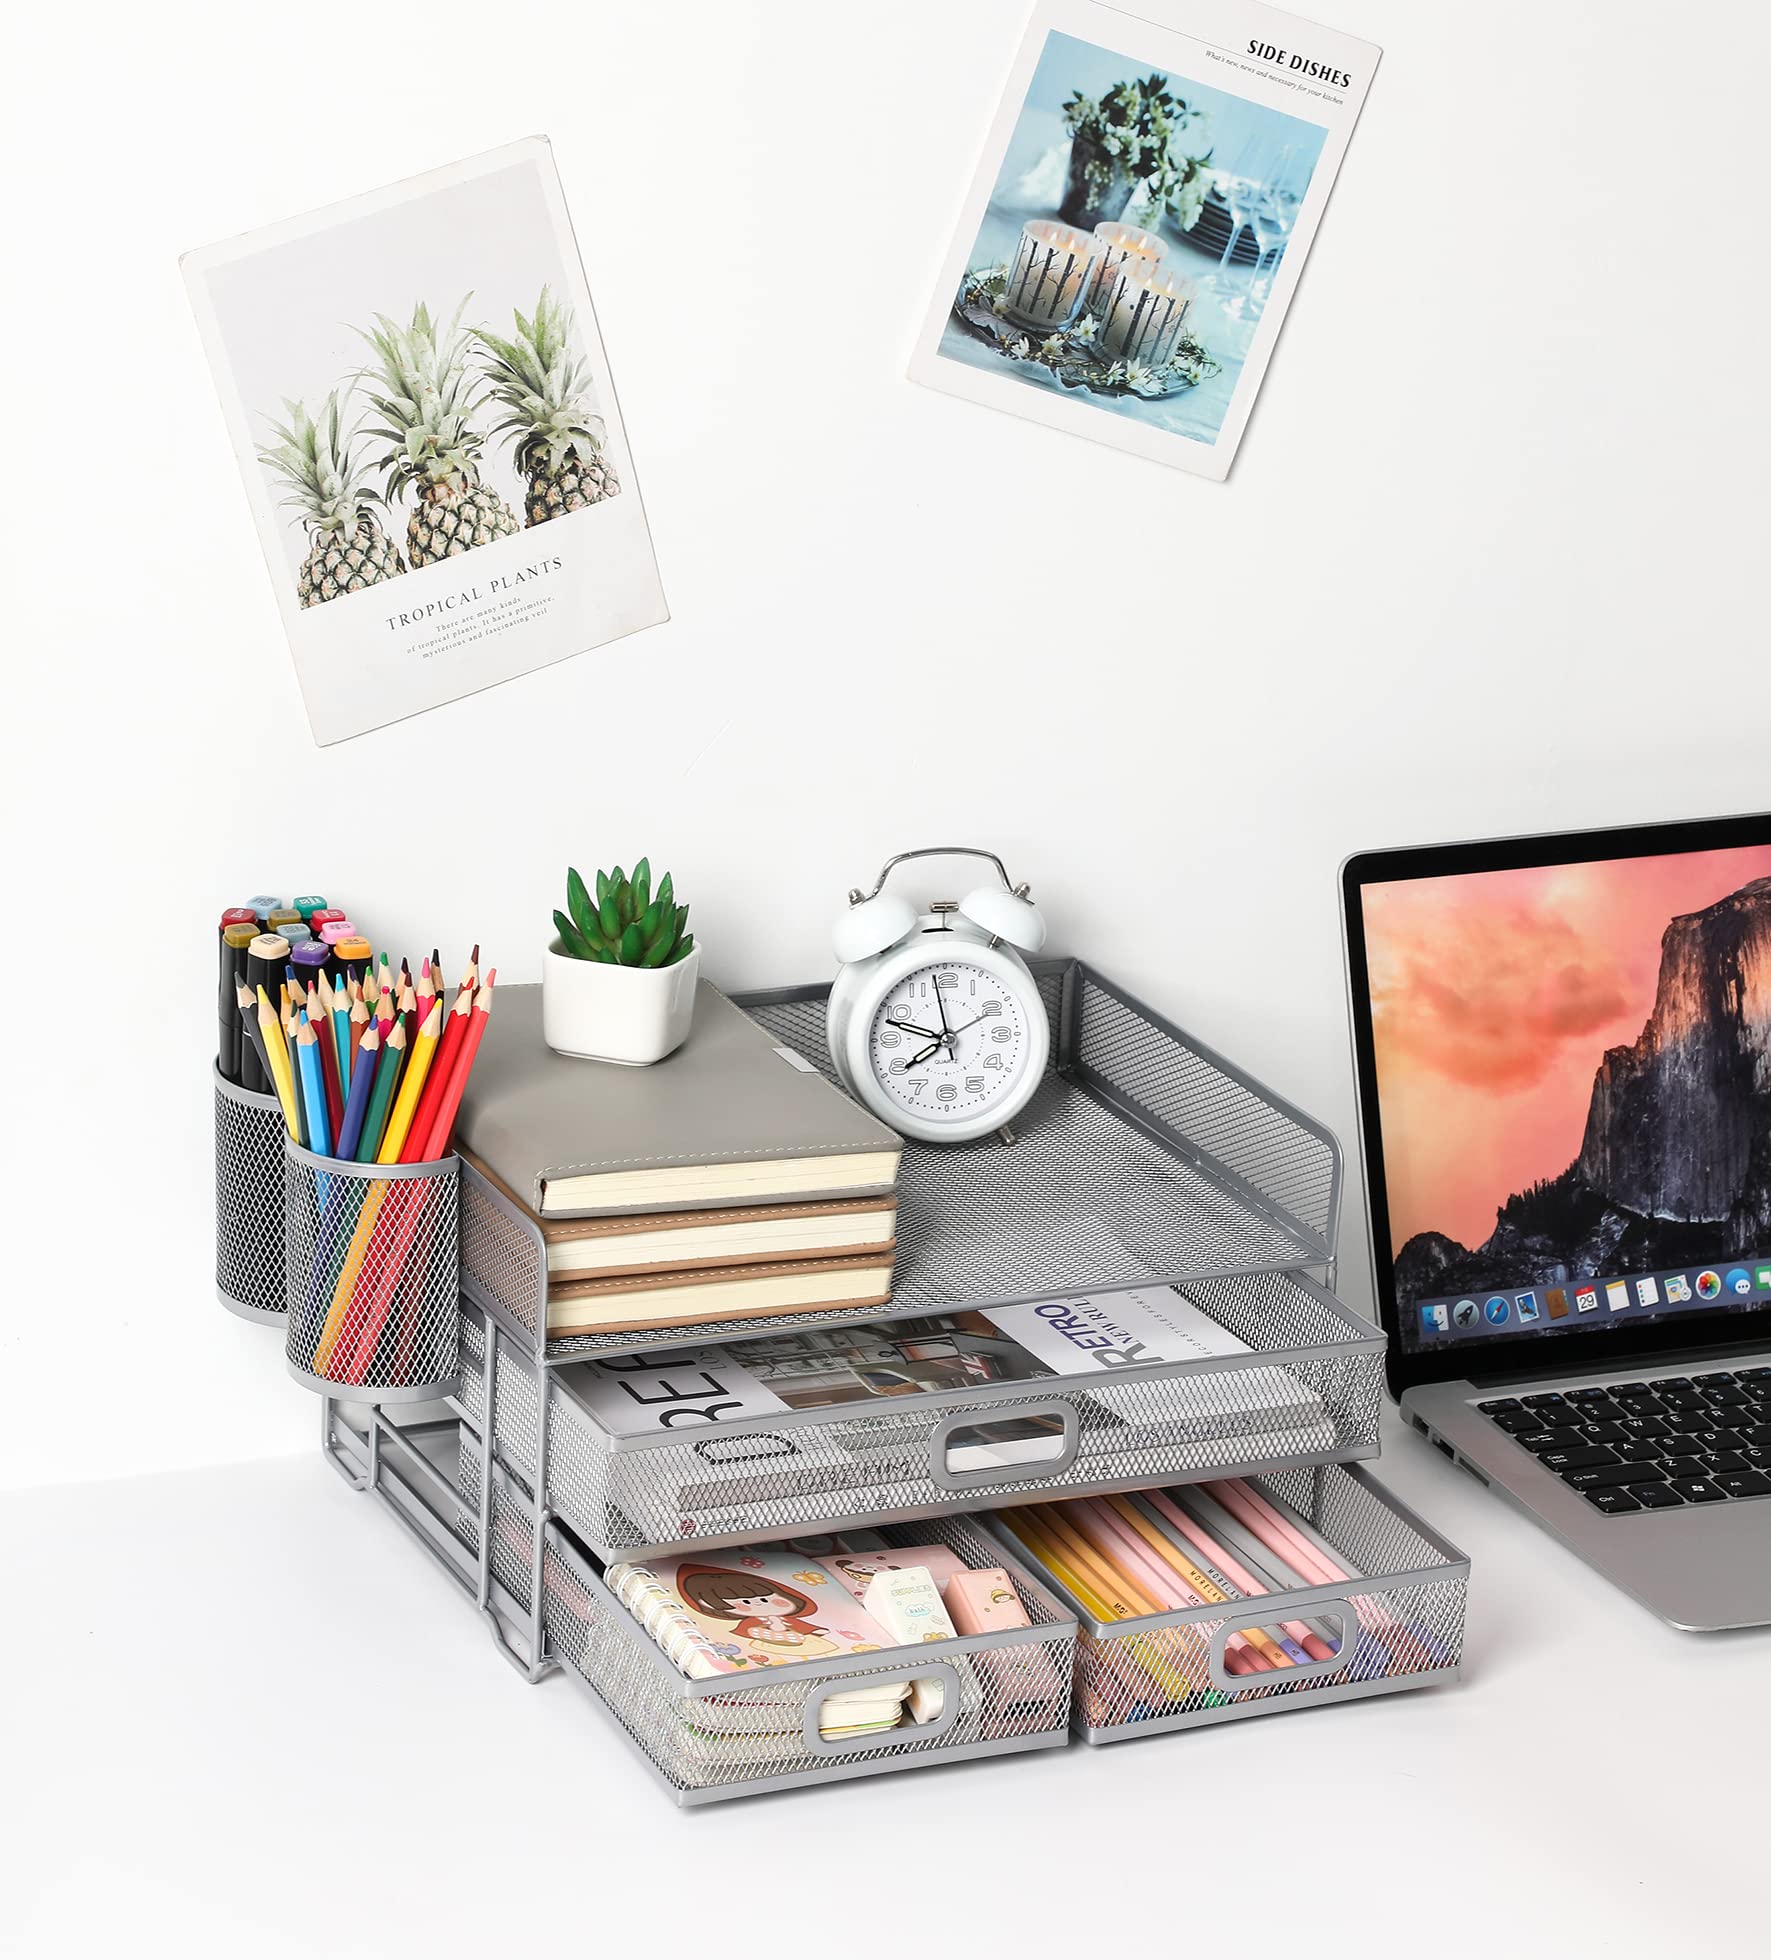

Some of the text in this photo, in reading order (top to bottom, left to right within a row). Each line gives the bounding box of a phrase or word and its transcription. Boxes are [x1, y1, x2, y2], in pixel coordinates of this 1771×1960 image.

[1246, 39, 1352, 88] SIDE DISHES
[1205, 50, 1344, 105] What's new, news and necessary for your kitchen
[385, 556, 563, 631] TROPICAL PLANTS
[436, 597, 521, 632] There are many kinds
[406, 645, 416, 654] of
[418, 634, 450, 650] tropical
[482, 618, 490, 626] It
[492, 612, 505, 623] has
[422, 608, 548, 659] mysterious and fascinating veil
[909, 982, 926, 998] 11
[886, 1003, 912, 1022] 10
[981, 1000, 1003, 1017] 2
[879, 1030, 902, 1049] 9
[991, 1026, 1012, 1043] 3
[888, 1057, 909, 1076] 8
[983, 1053, 1004, 1071] 4
[908, 1078, 928, 1096] 7
[935, 1084, 958, 1102] 6
[964, 1076, 985, 1094] 5
[1579, 1294, 1595, 1309] 29
